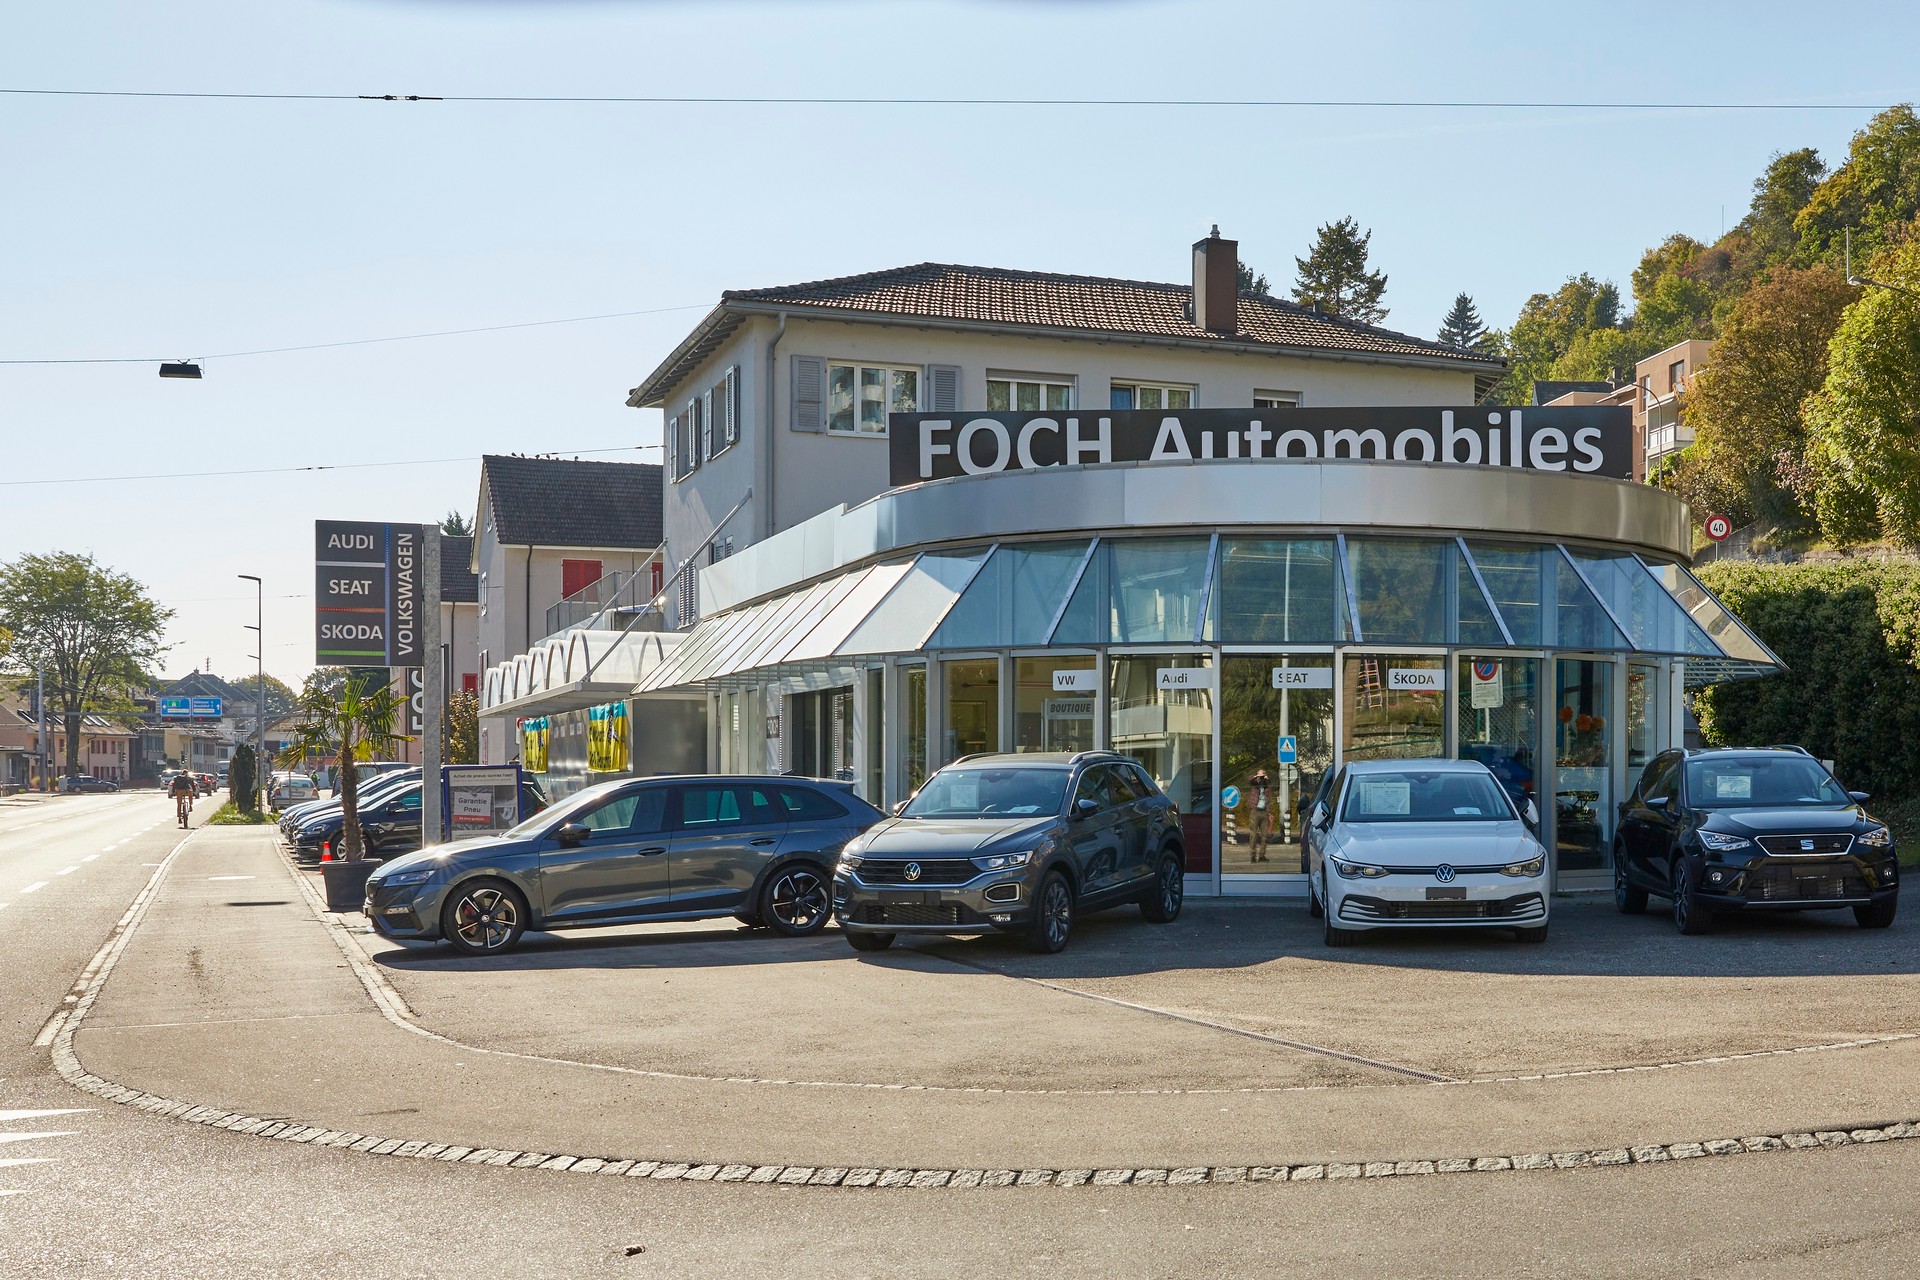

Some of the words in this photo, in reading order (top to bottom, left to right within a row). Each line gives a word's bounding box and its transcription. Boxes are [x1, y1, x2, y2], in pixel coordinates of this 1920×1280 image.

[919, 417, 1112, 478] FOCH
[1149, 410, 1604, 472] Automobiles
[1713, 523, 1724, 532] 40
[328, 533, 374, 549] AUDI
[329, 579, 373, 595] SEAT
[398, 533, 413, 656] VOLKSWAGEN
[321, 624, 384, 640] SKODA
[1057, 675, 1076, 685] VW
[1161, 673, 1188, 684] Audi
[1278, 672, 1309, 683] SEAT
[1393, 671, 1435, 685] ŠKODA
[1050, 703, 1091, 713] BOUTIQUE
[458, 797, 487, 805] Garantie
